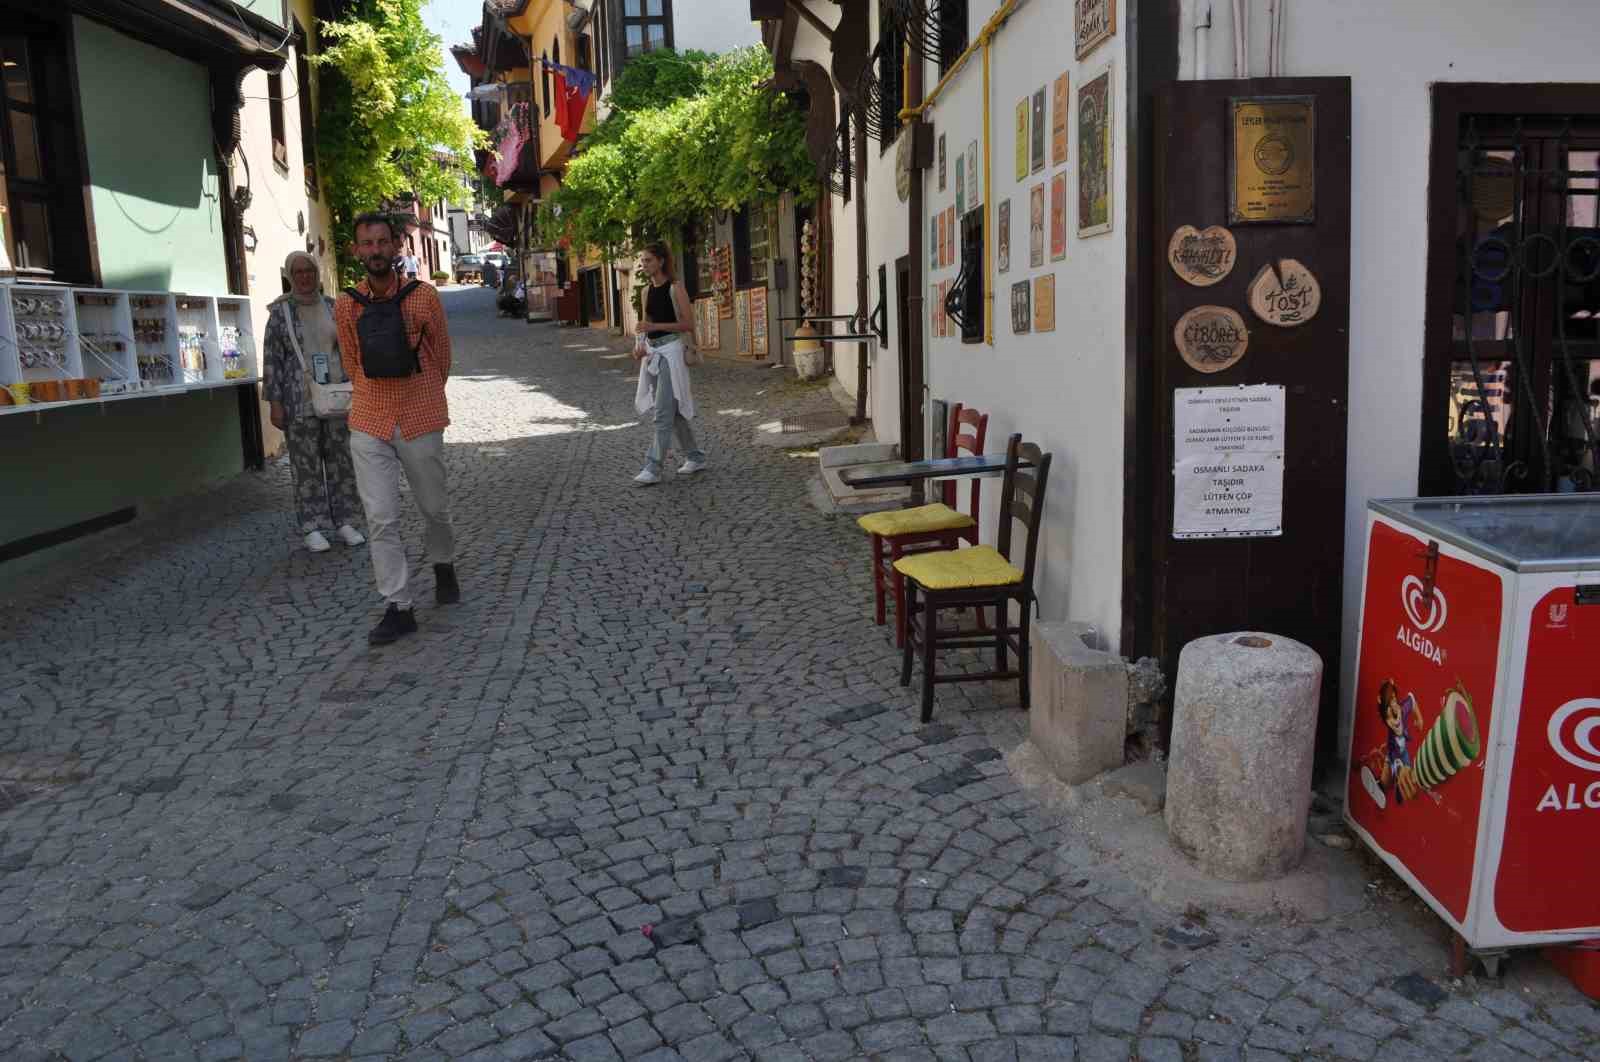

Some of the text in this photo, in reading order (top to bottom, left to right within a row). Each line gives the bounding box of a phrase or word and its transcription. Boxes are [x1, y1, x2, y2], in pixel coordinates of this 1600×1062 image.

[1265, 285, 1313, 312] TOST
[1193, 464, 1265, 474] OSMANLI SADAKA
[1212, 478, 1244, 487] TAŞIDIR
[1203, 491, 1253, 502] LÜTFEN ÇÖP
[1205, 506, 1250, 515] ATMAYINIZ
